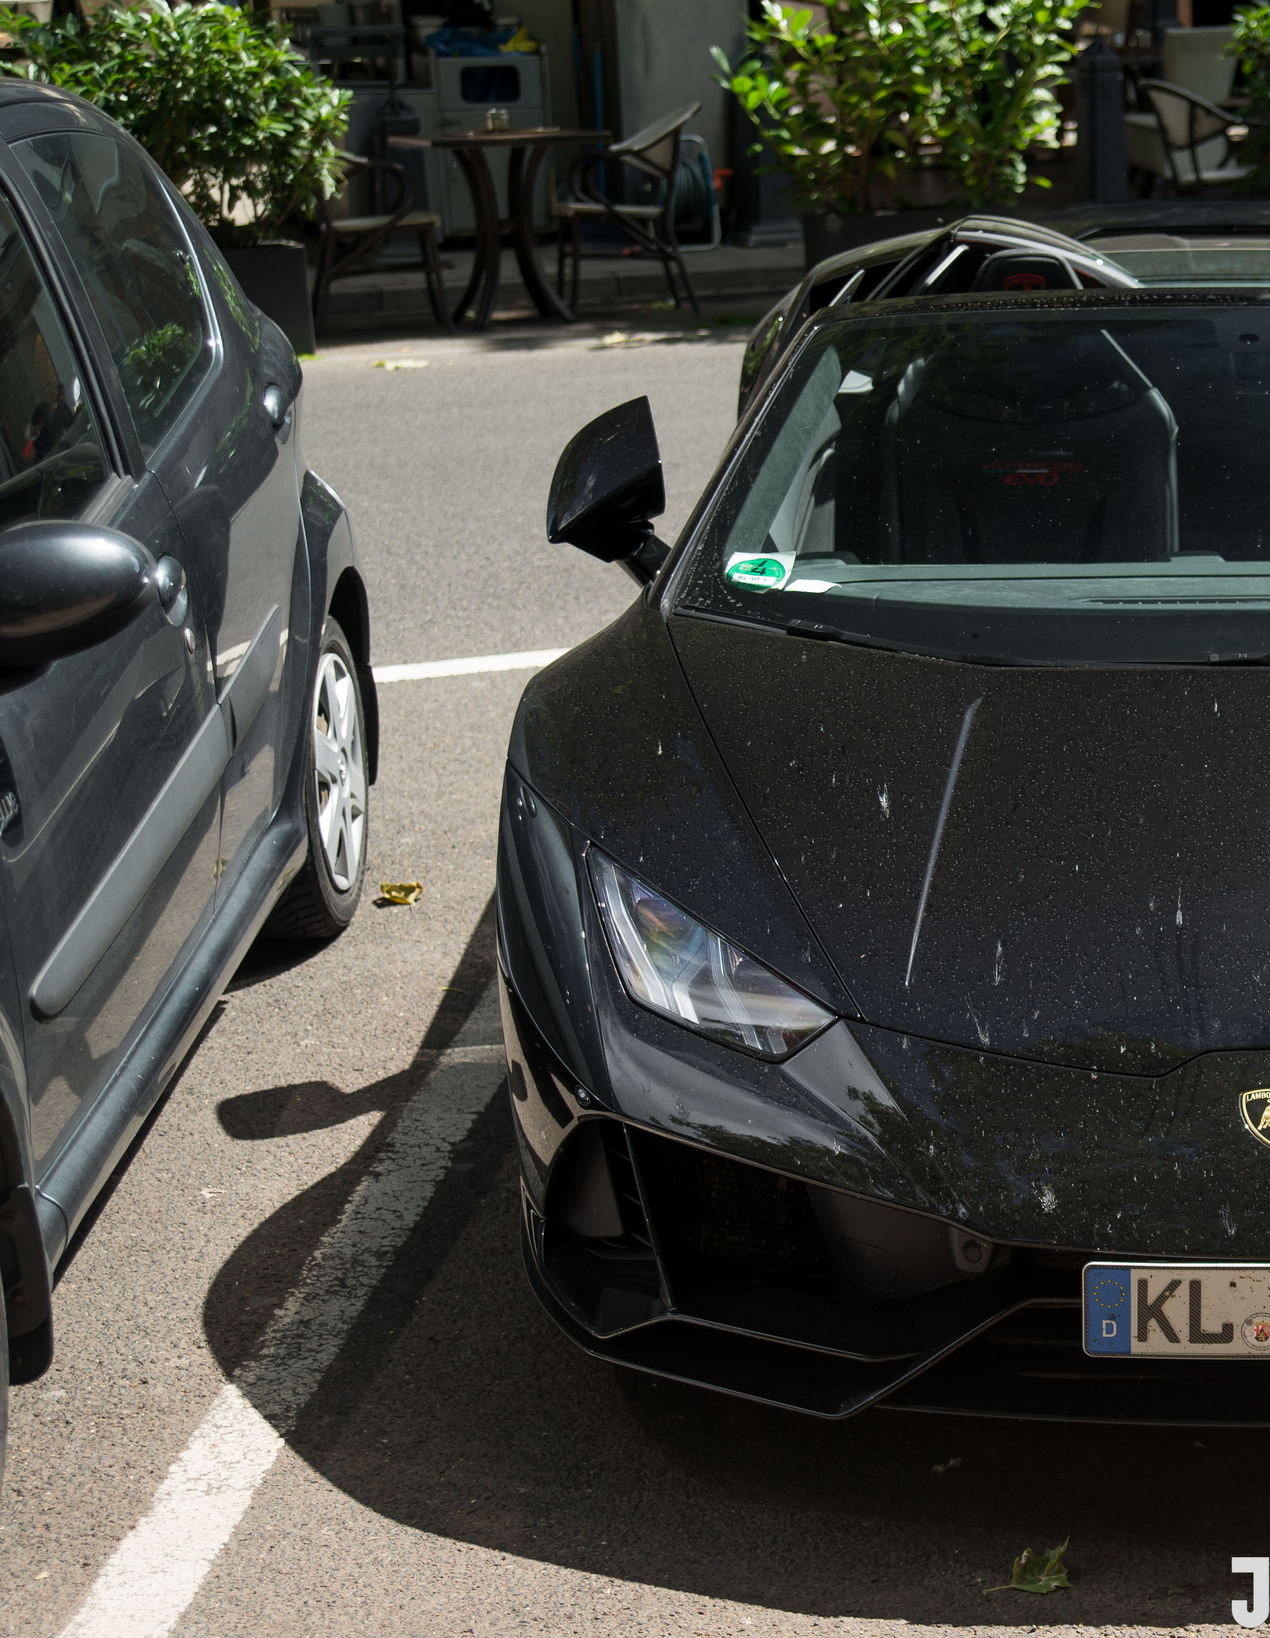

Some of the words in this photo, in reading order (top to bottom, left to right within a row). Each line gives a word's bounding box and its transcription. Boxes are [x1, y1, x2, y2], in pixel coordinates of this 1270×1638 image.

[1003, 473, 1060, 486] EVO
[751, 560, 767, 576] 4
[1137, 1278, 1234, 1344] KL
[1101, 1319, 1117, 1338] D
